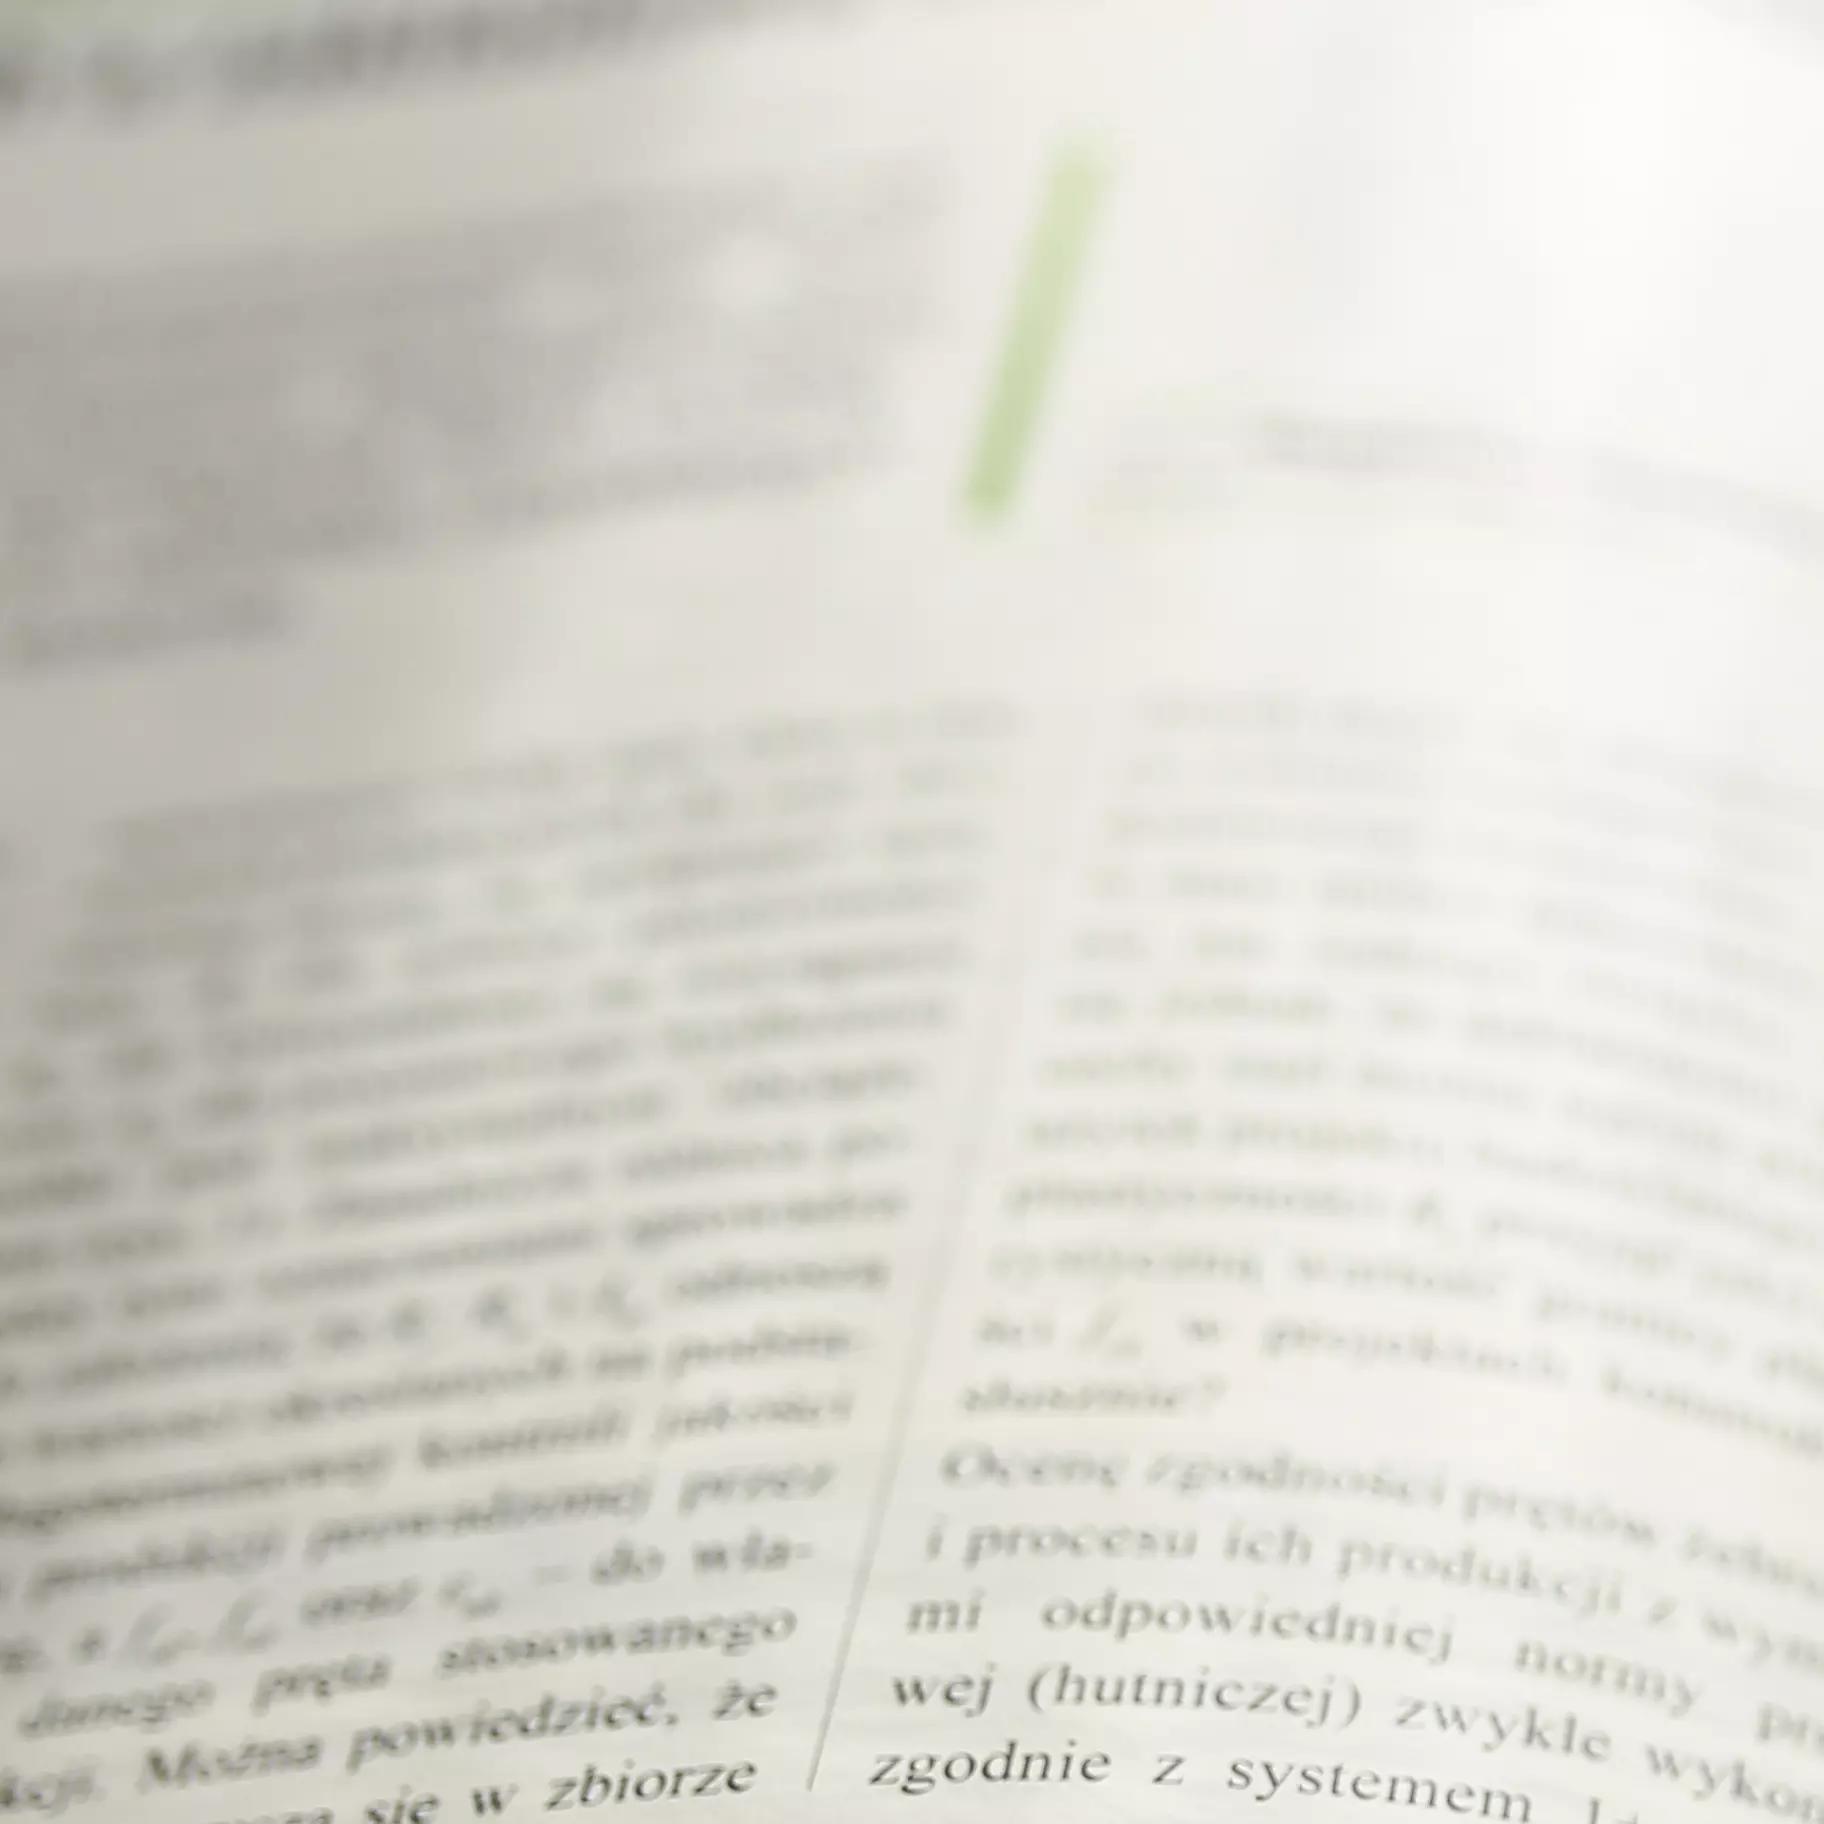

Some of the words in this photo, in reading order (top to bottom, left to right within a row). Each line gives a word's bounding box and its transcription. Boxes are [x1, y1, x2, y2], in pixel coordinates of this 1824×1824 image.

[925, 1514, 948, 1561] i
[963, 1523, 1198, 1570] procesu
[1223, 1518, 1312, 1565] ich
[1336, 1537, 1622, 1619] produkcji
[438, 1607, 797, 1675] stosowanego
[906, 1588, 986, 1636] mi
[1042, 1588, 1452, 1667] odpowiedniej
[1515, 1637, 1702, 1717] normy
[136, 1735, 325, 1794] Można
[346, 1681, 679, 1775] powiedzieć,
[712, 1679, 779, 1720] że
[890, 1661, 1000, 1718] wej
[1026, 1663, 1362, 1729] (hutniczej)
[1395, 1697, 1613, 1763] zwykle
[471, 1783, 518, 1817] w
[544, 1758, 758, 1812] zbiorze
[868, 1739, 1112, 1796] zgodnie
[1151, 1752, 1186, 1787] z
[1226, 1756, 1534, 1824] systemem
